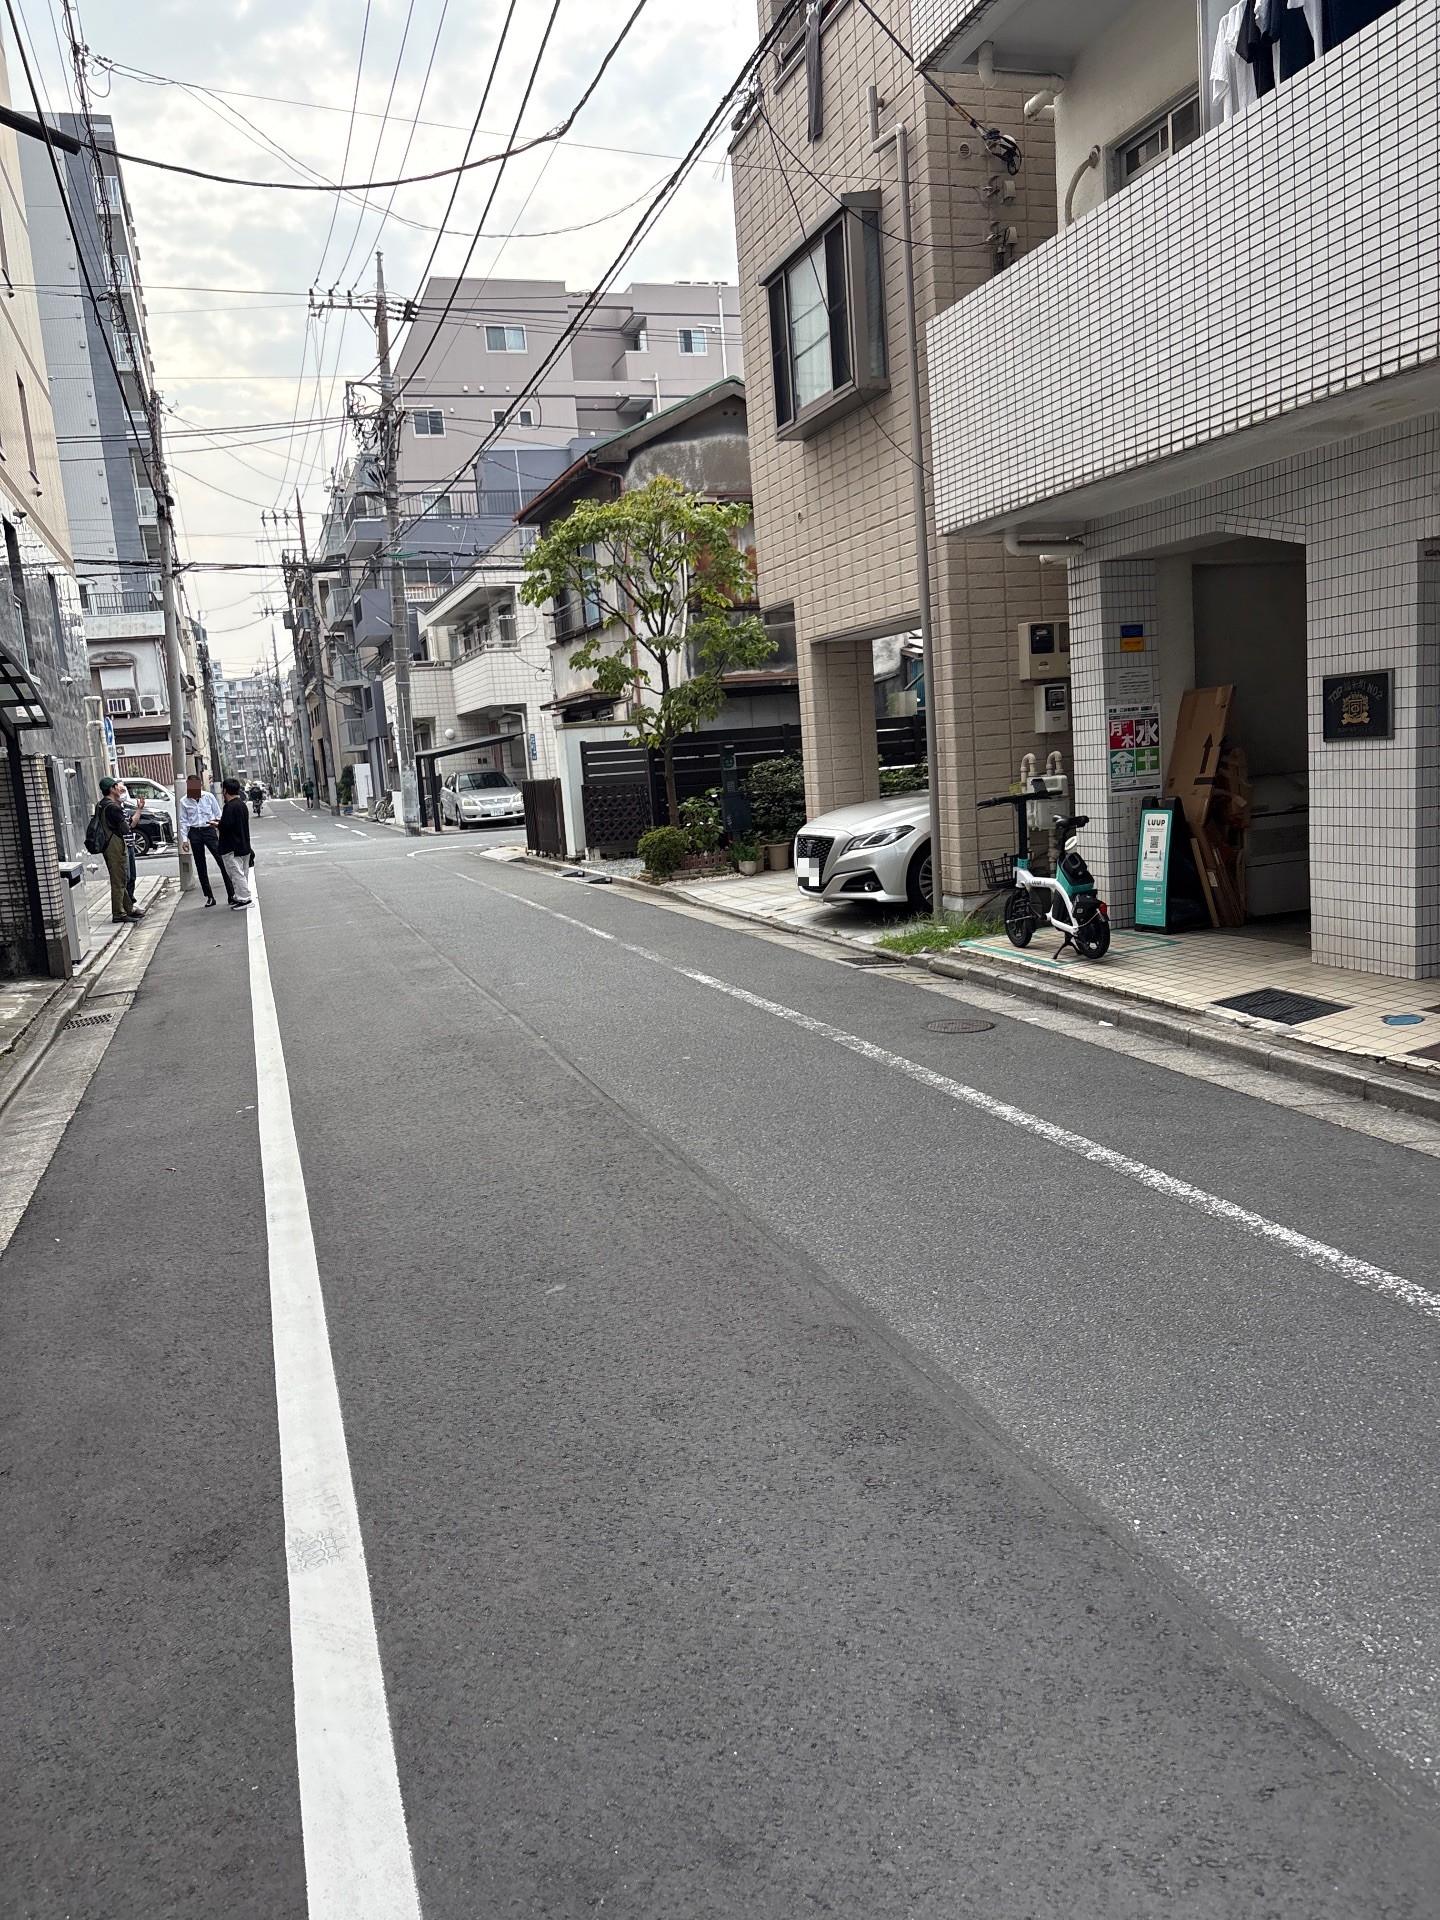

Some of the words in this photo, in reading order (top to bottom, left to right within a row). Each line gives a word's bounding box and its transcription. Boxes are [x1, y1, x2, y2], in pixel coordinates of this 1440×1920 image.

[1328, 686, 1343, 703] TOP
[1110, 721, 1122, 737] 月
[1136, 720, 1159, 746] 水
[1121, 733, 1134, 748] 木
[1110, 751, 1135, 778] 金
[1136, 750, 1160, 776] 土
